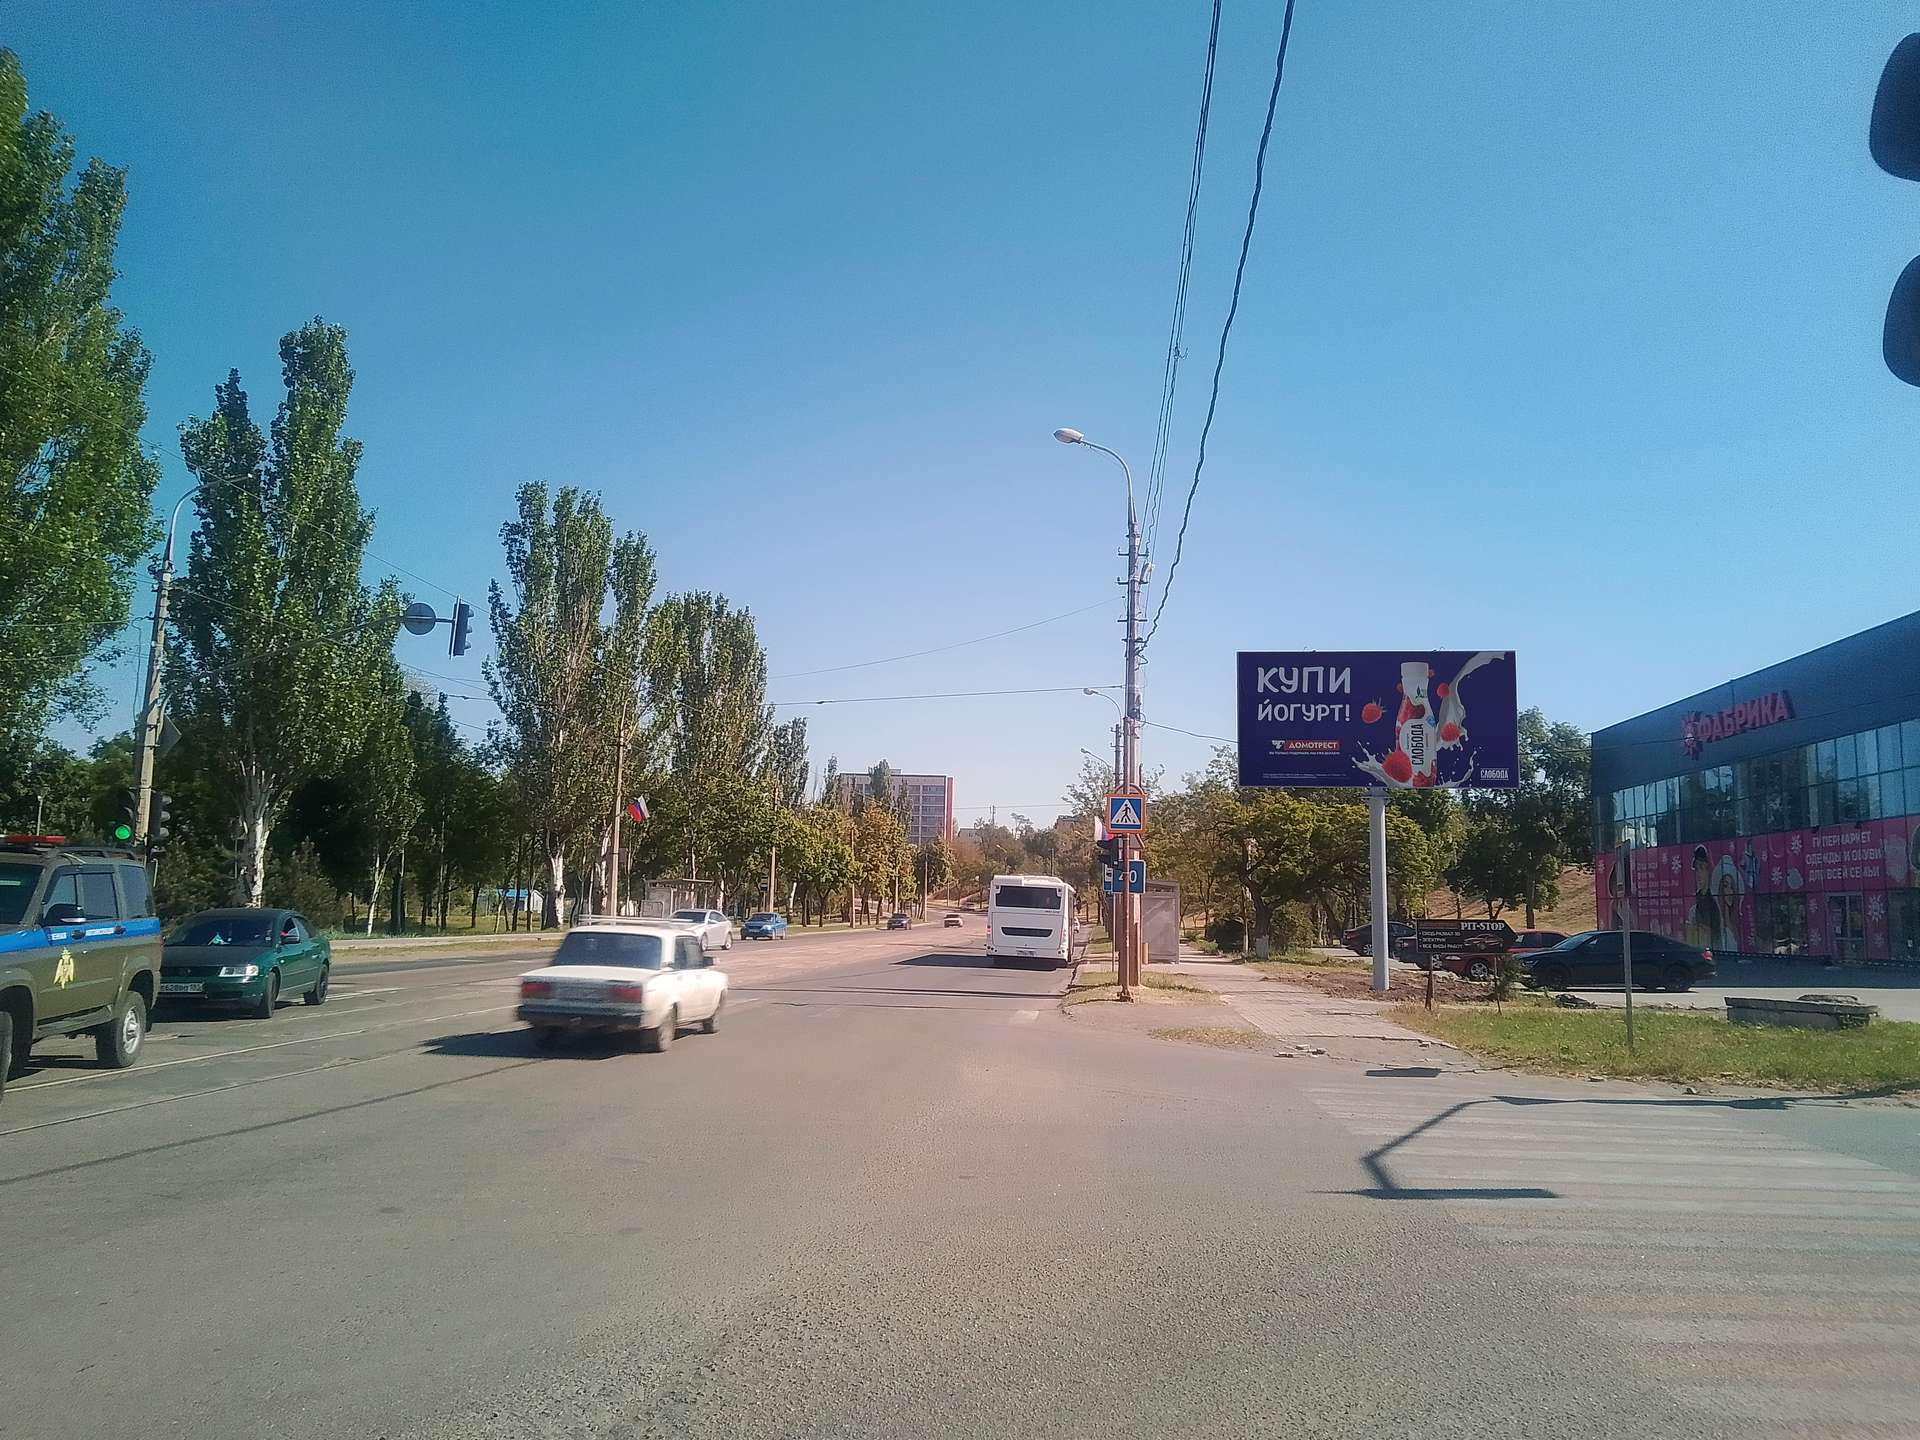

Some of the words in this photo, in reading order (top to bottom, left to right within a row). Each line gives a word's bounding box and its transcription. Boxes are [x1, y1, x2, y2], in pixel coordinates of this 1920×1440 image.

[1256, 666, 1351, 694] КУПИ
[1257, 699, 1351, 722] ЙОГУРТ!
[1696, 689, 1788, 742] ФАБРИКА
[1288, 741, 1338, 750] ДОМОТРЕСТ
[1411, 723, 1424, 766] СЛОБОДА
[1480, 769, 1509, 780] СЛОБОДА
[1460, 922, 1505, 931] PIT-STOP
